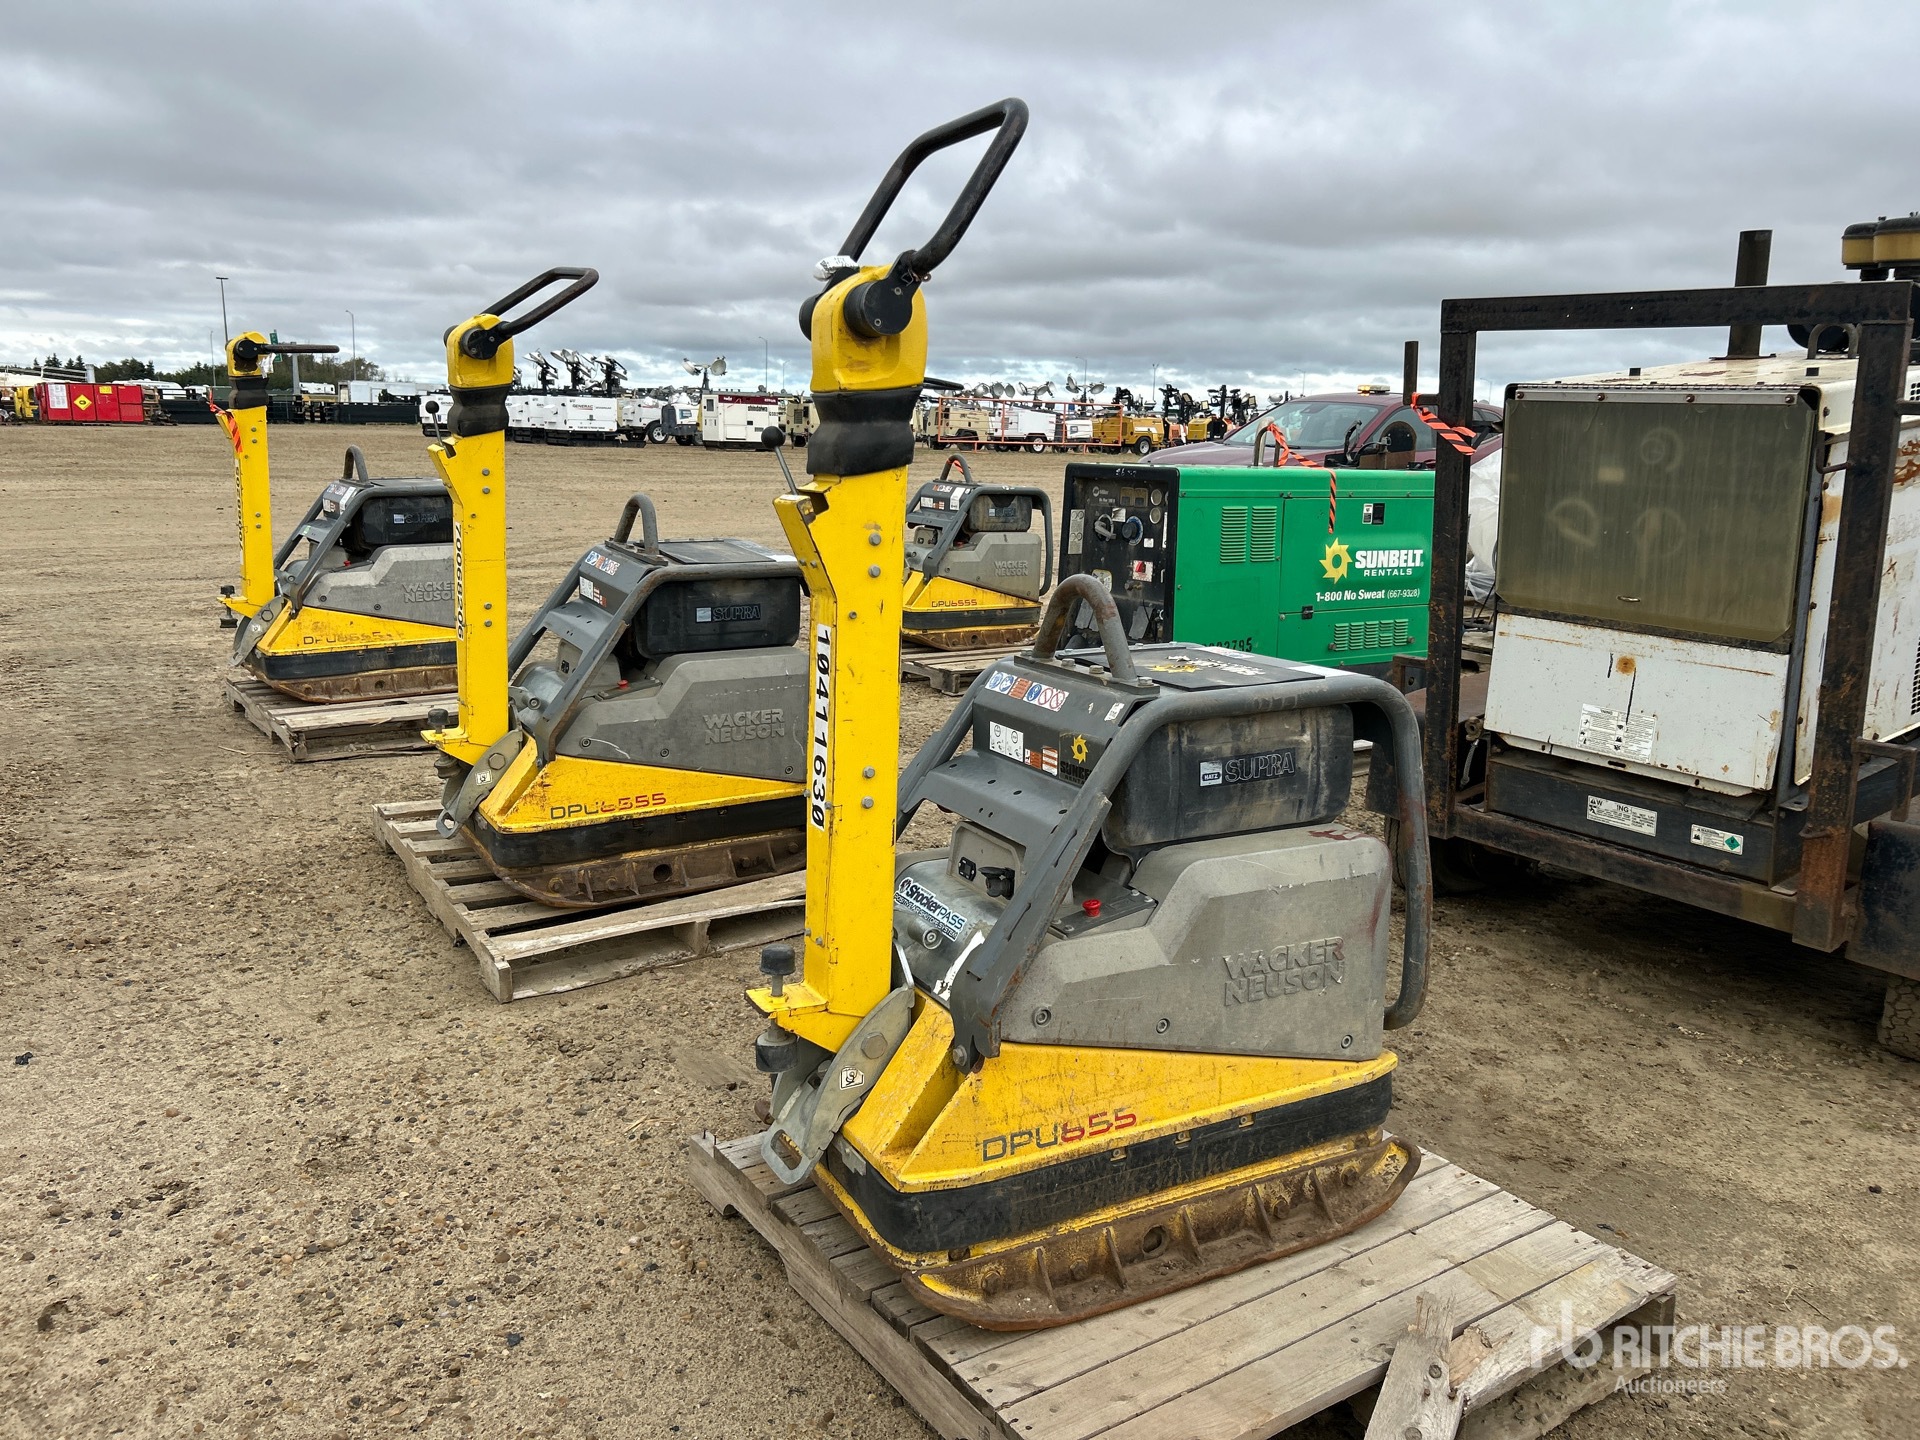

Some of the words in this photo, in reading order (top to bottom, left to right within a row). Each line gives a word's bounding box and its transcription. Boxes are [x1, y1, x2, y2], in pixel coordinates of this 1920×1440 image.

[994, 560, 1028, 569] WACKER
[1355, 549, 1424, 569] SUNBELT
[995, 568, 1028, 577] NEUSON
[1363, 568, 1413, 577] RENTALS
[401, 581, 455, 594] WACKE
[1315, 591, 1342, 602] 1-800
[1343, 590, 1356, 600] No
[1358, 589, 1385, 599] Sweat
[1387, 588, 1421, 599] (667-9328)
[712, 605, 761, 621] SUPRA
[703, 708, 785, 729] WACKER
[704, 724, 785, 746] NEUSON
[811, 628, 831, 830] 10411630
[1204, 773, 1218, 781] HATZ
[1224, 751, 1295, 783] SUPRA
[550, 792, 667, 820] DPU6555
[1222, 936, 1345, 980] WACKER
[1223, 961, 1344, 1007] NEUSON
